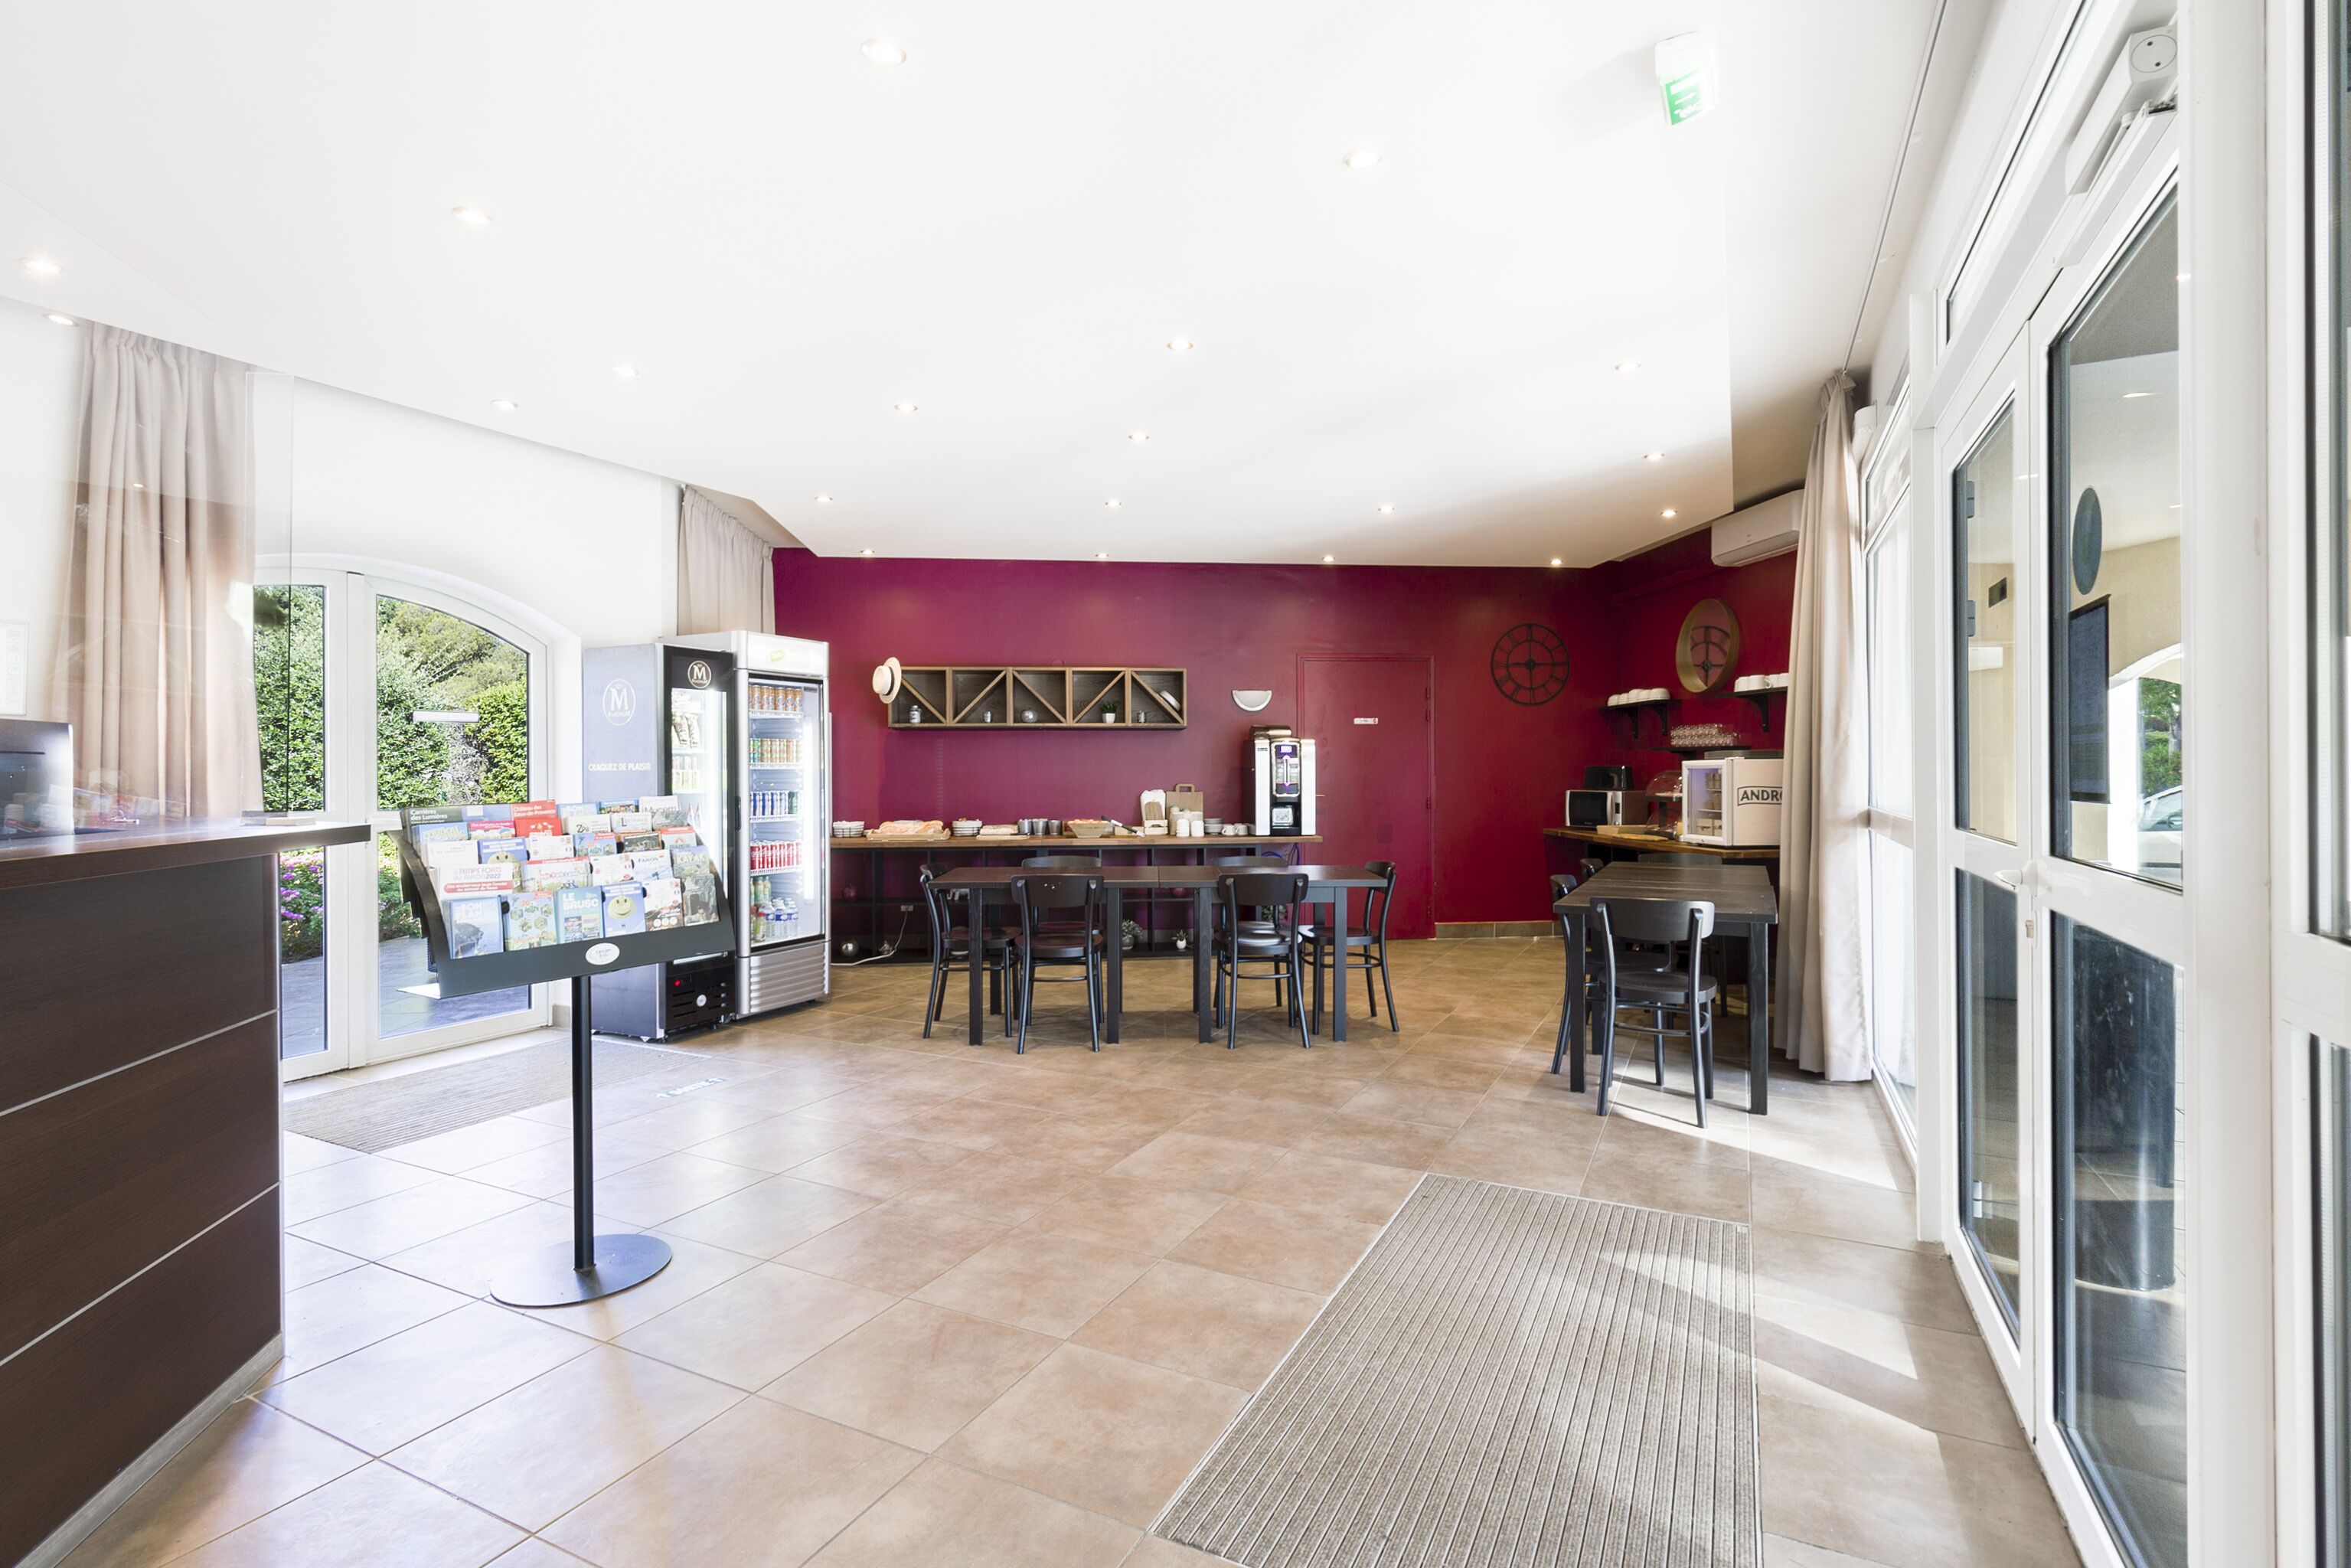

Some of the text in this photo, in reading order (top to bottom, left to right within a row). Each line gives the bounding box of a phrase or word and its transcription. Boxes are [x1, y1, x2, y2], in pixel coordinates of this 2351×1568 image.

[694, 665, 707, 680] M
[610, 688, 629, 710] M
[628, 762, 651, 770] PLAISIR
[1740, 789, 1783, 802] ANDR
[563, 892, 575, 901] LE
